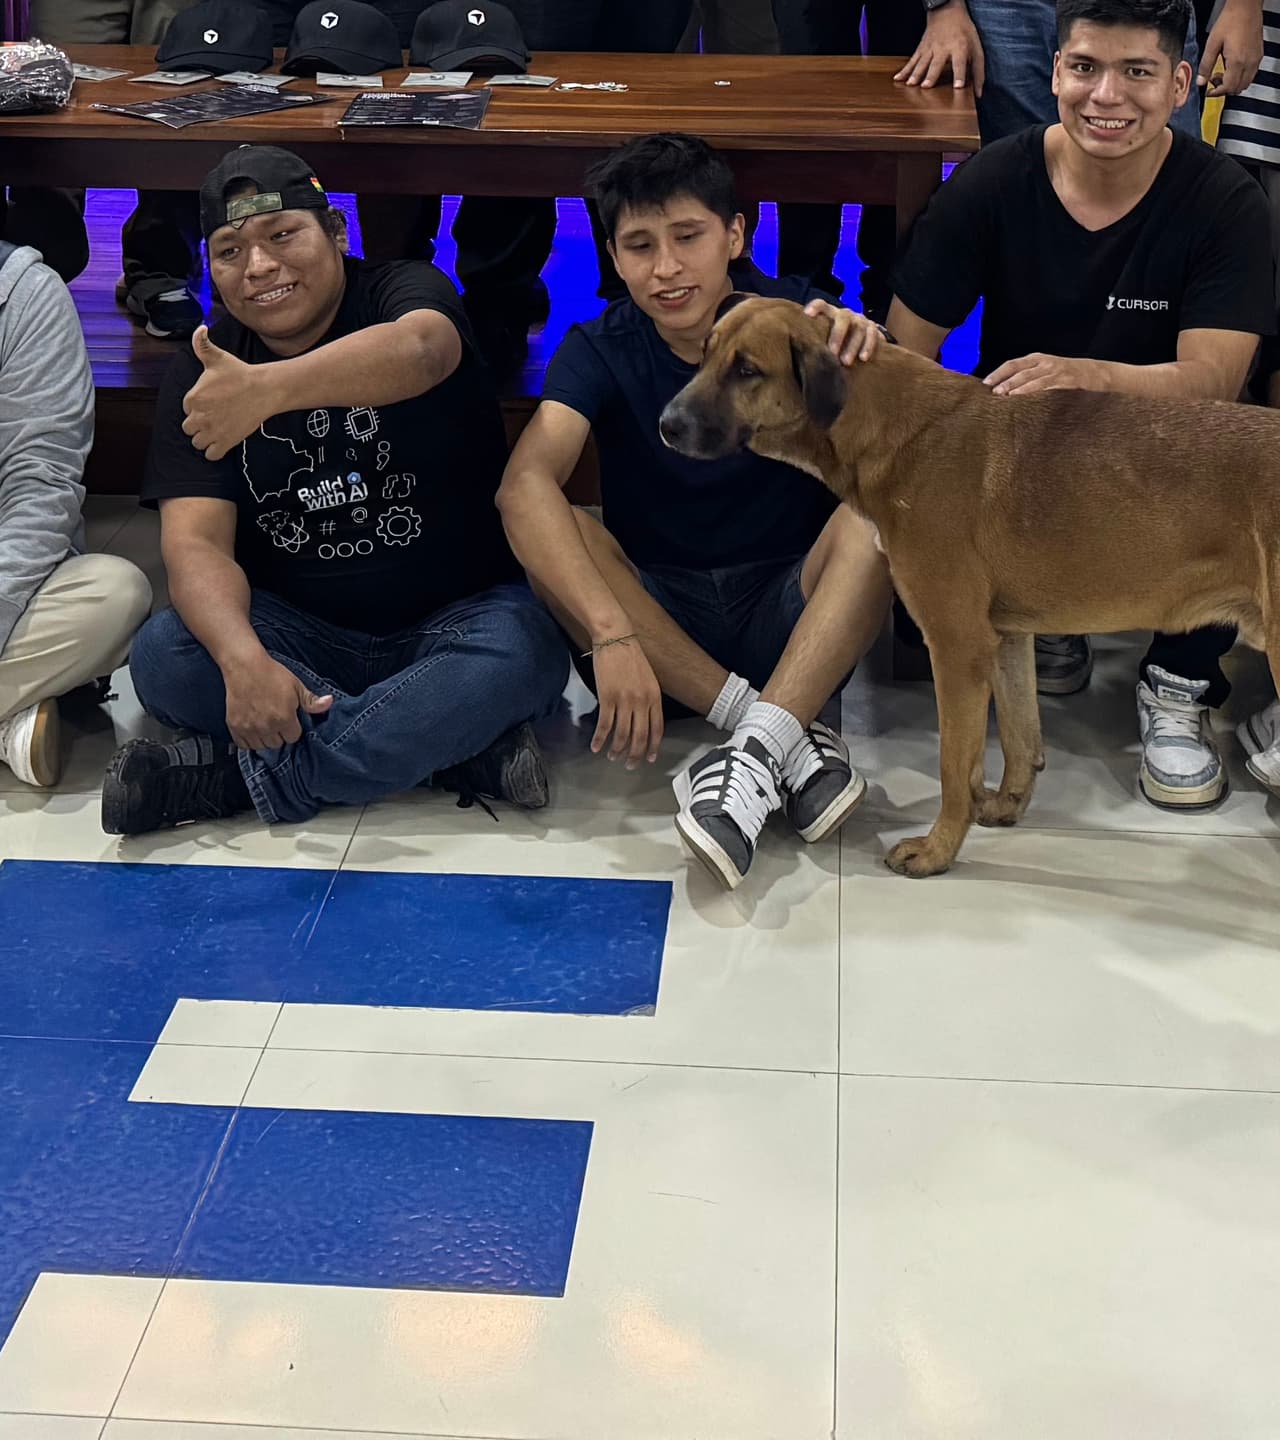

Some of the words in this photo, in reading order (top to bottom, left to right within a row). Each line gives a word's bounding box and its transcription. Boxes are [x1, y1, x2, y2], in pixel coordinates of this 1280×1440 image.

[1117, 298, 1169, 311] CURSOR
[297, 475, 344, 502] Build
[305, 490, 346, 510] with
[350, 482, 369, 501] AI
